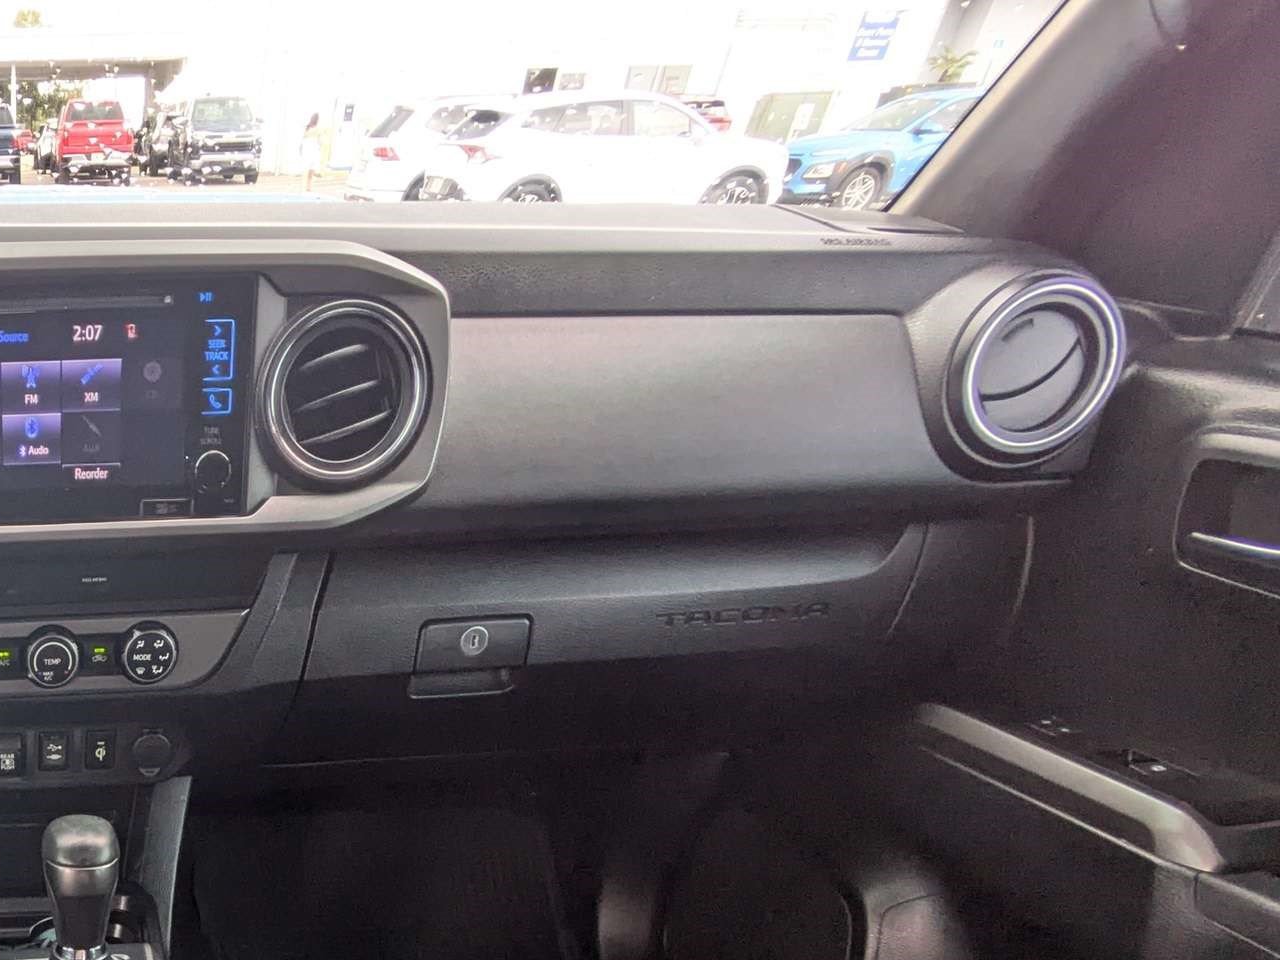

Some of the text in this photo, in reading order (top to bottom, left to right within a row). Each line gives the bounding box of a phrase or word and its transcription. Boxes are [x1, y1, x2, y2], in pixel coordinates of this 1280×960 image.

[72, 324, 103, 341] 2:07
[204, 351, 229, 360] TRACK
[24, 394, 39, 405] FM
[83, 392, 99, 402] XM
[28, 445, 49, 456] Audio
[74, 467, 109, 480] Reorder
[655, 602, 831, 627] TACOMA
[43, 658, 61, 666] TEMP
